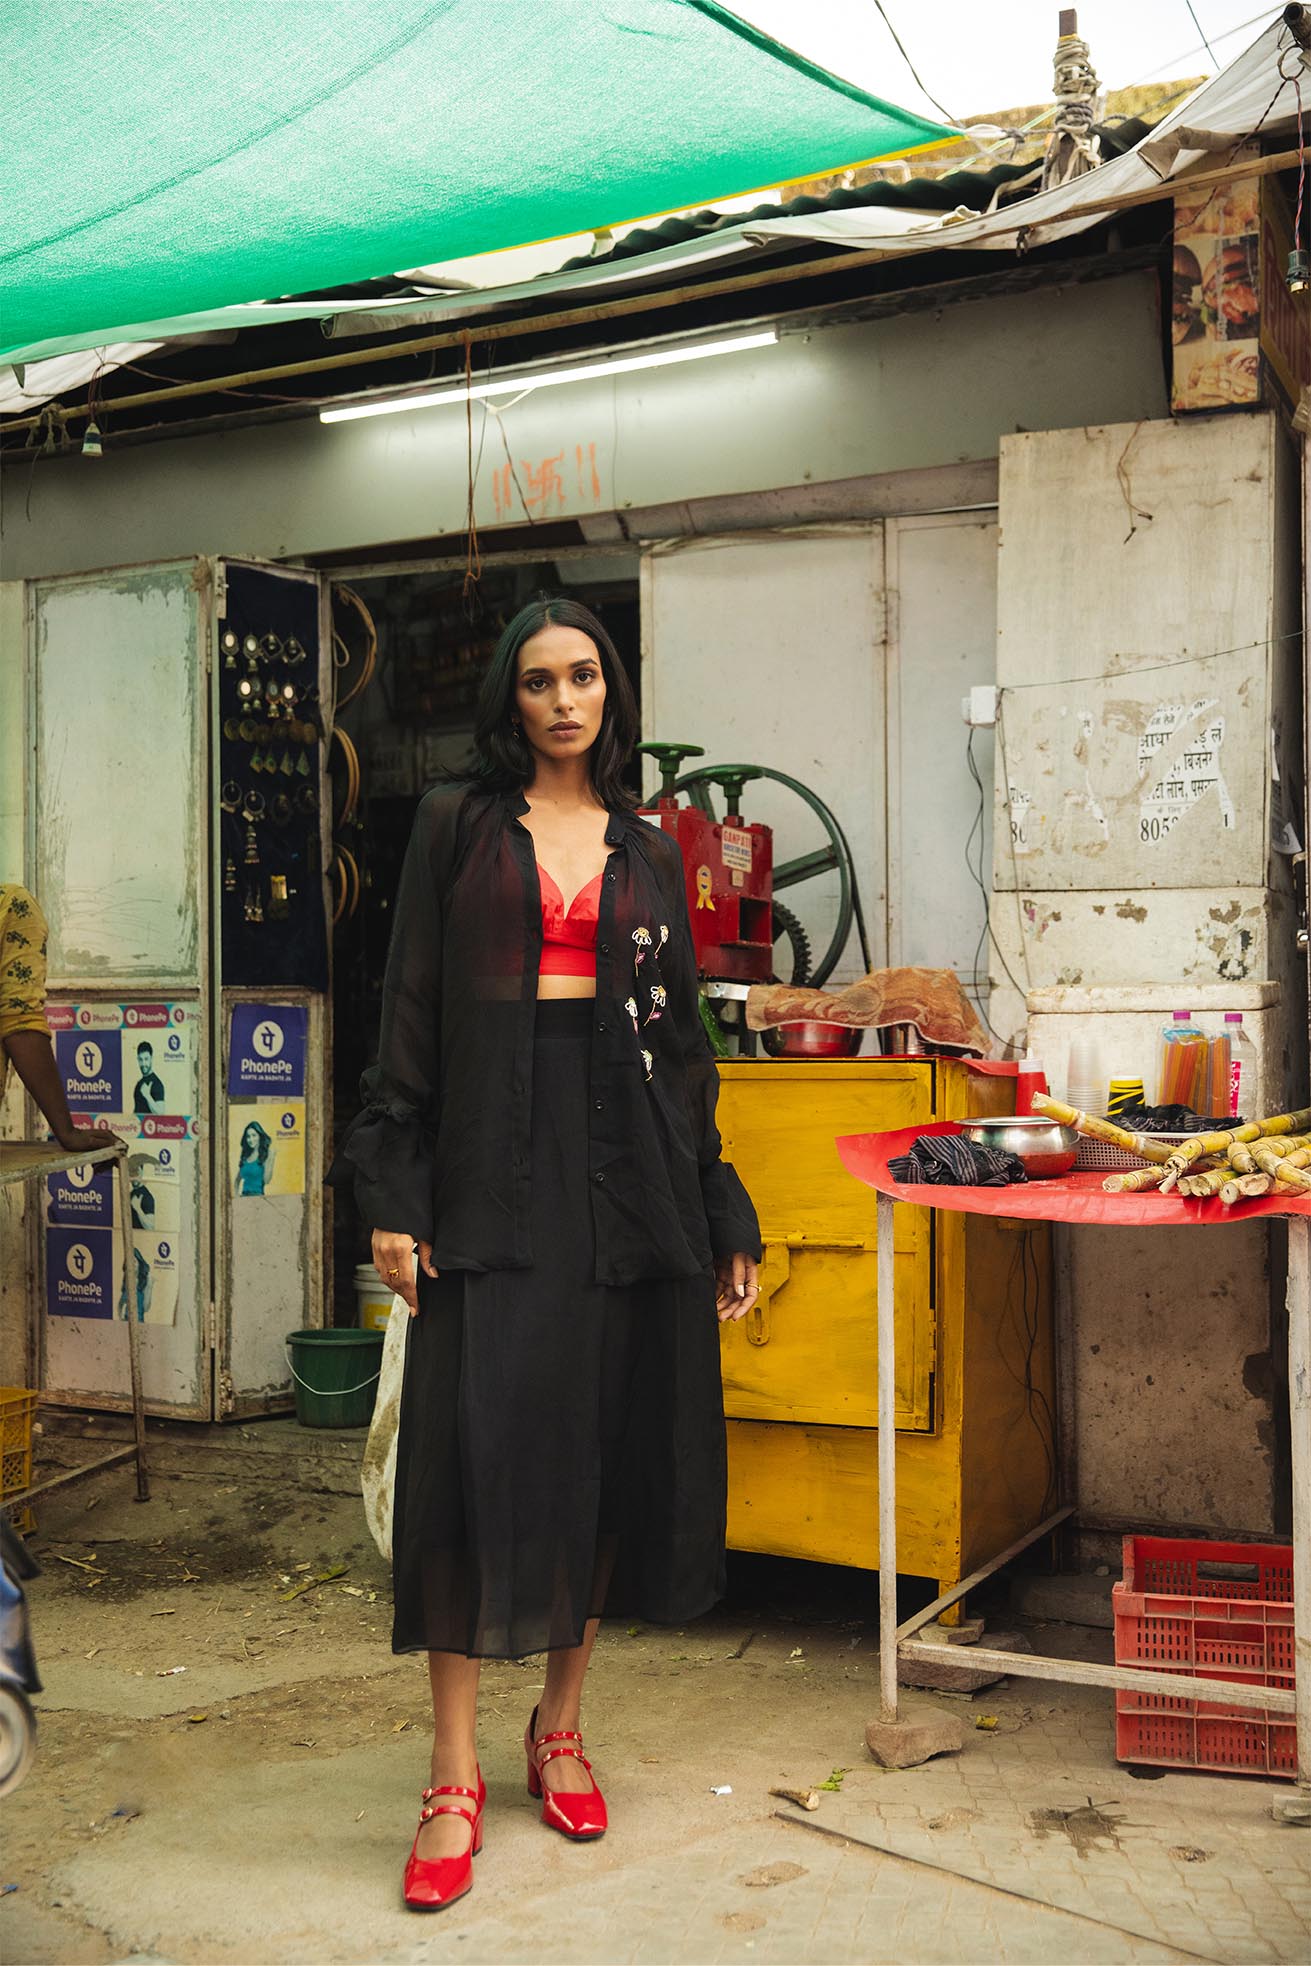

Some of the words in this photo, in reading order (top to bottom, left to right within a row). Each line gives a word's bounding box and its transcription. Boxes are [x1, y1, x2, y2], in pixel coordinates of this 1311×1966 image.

[241, 1058, 292, 1074] PhonePe
[67, 1078, 112, 1093] PhonePe
[58, 1188, 102, 1204] PhonePe
[58, 1280, 102, 1296] PhonePe
